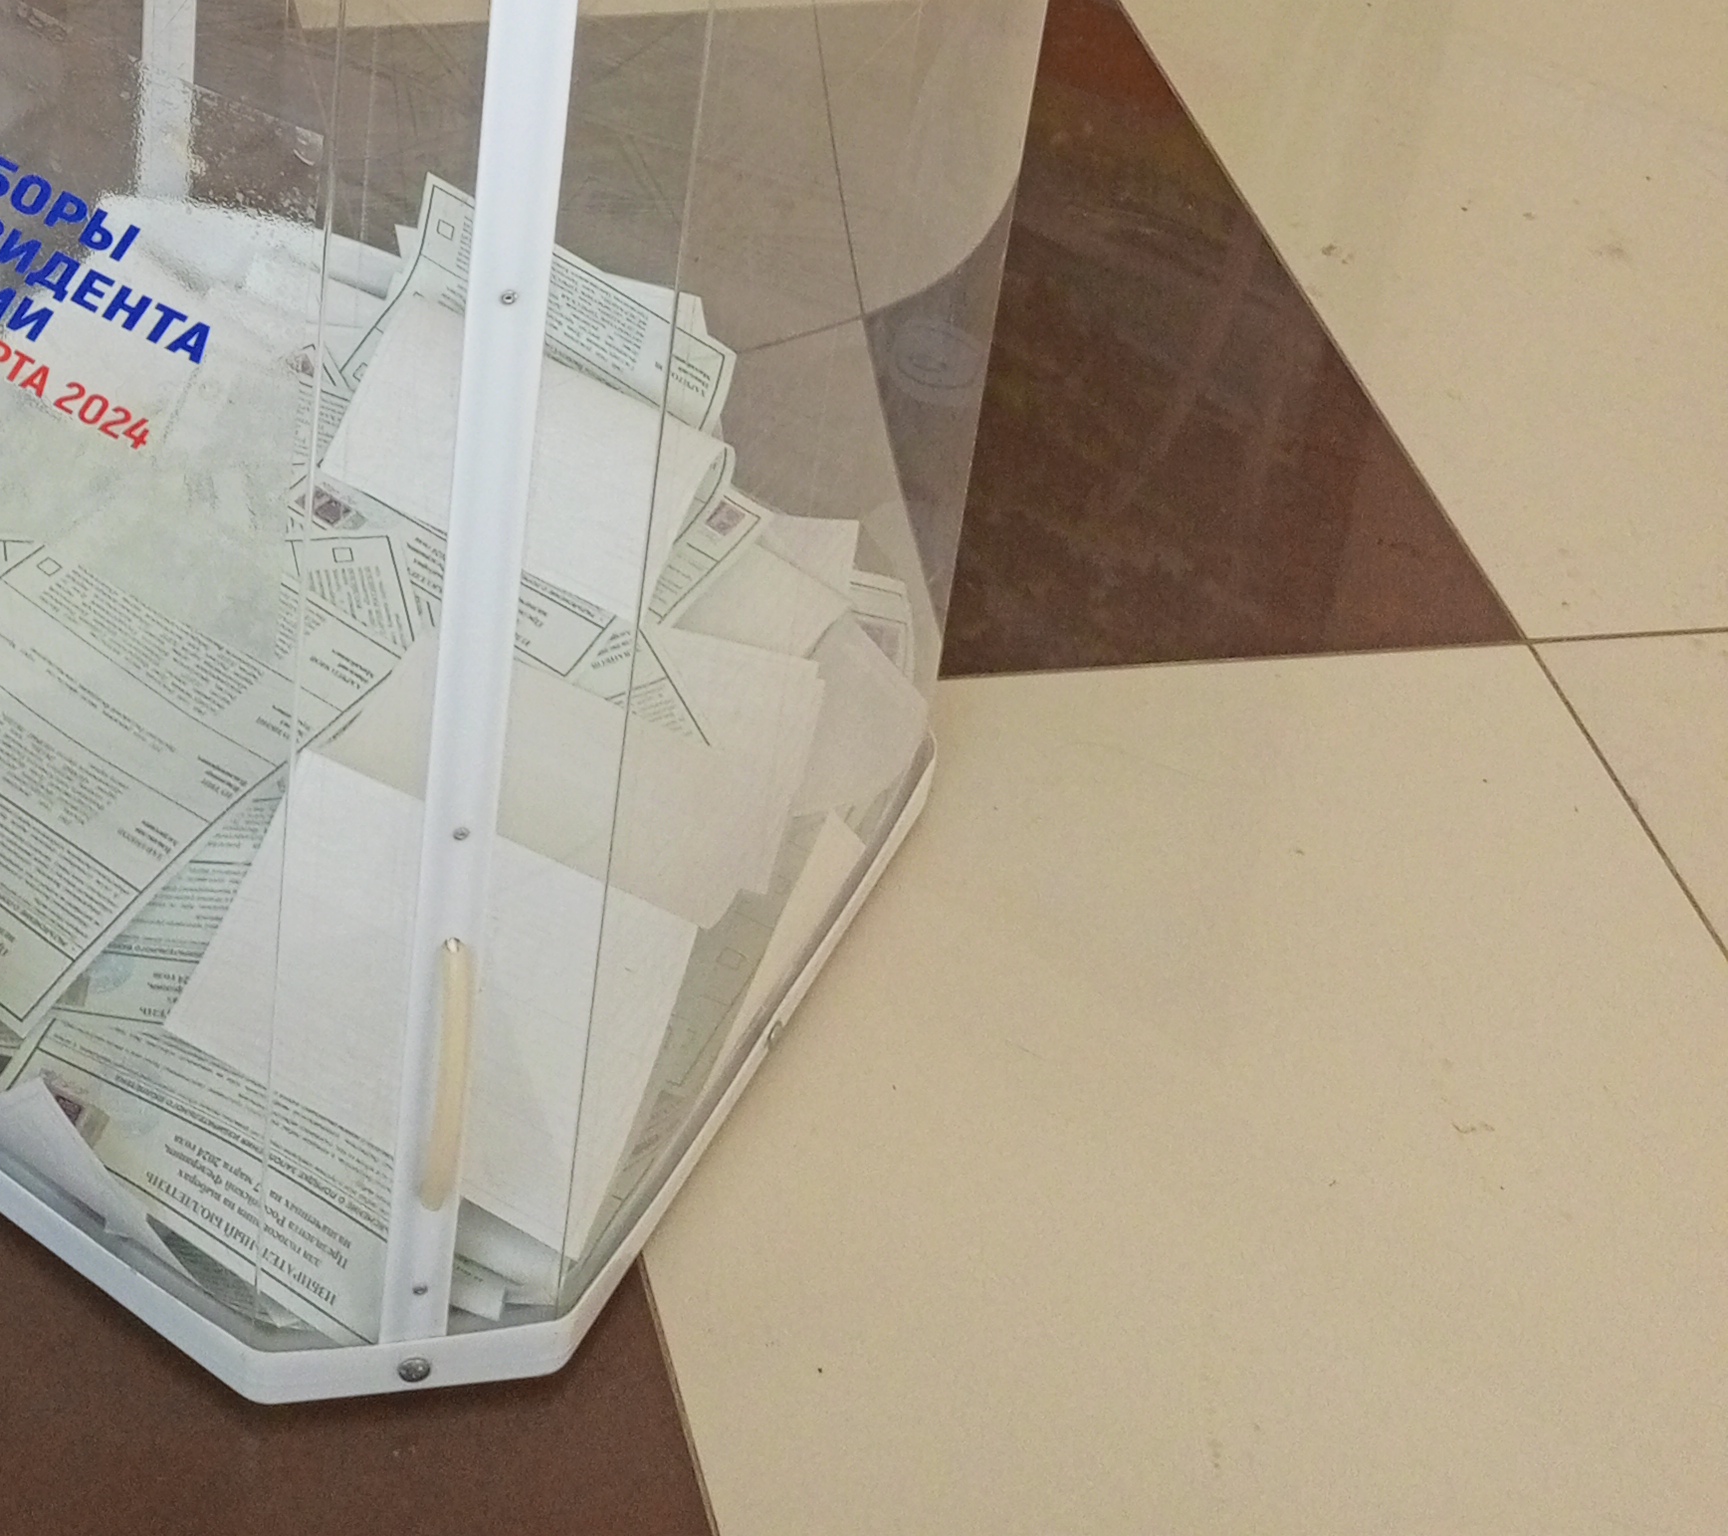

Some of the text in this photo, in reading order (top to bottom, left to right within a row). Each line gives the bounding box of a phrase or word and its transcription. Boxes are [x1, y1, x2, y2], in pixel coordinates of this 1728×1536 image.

[54, 381, 150, 449] 2024
[195, 1146, 221, 1168] 2024
[220, 1160, 254, 1185] марта
[142, 1170, 224, 1228] БЮЛЛЕТЕНЬ
[174, 1168, 221, 1202] выборах
